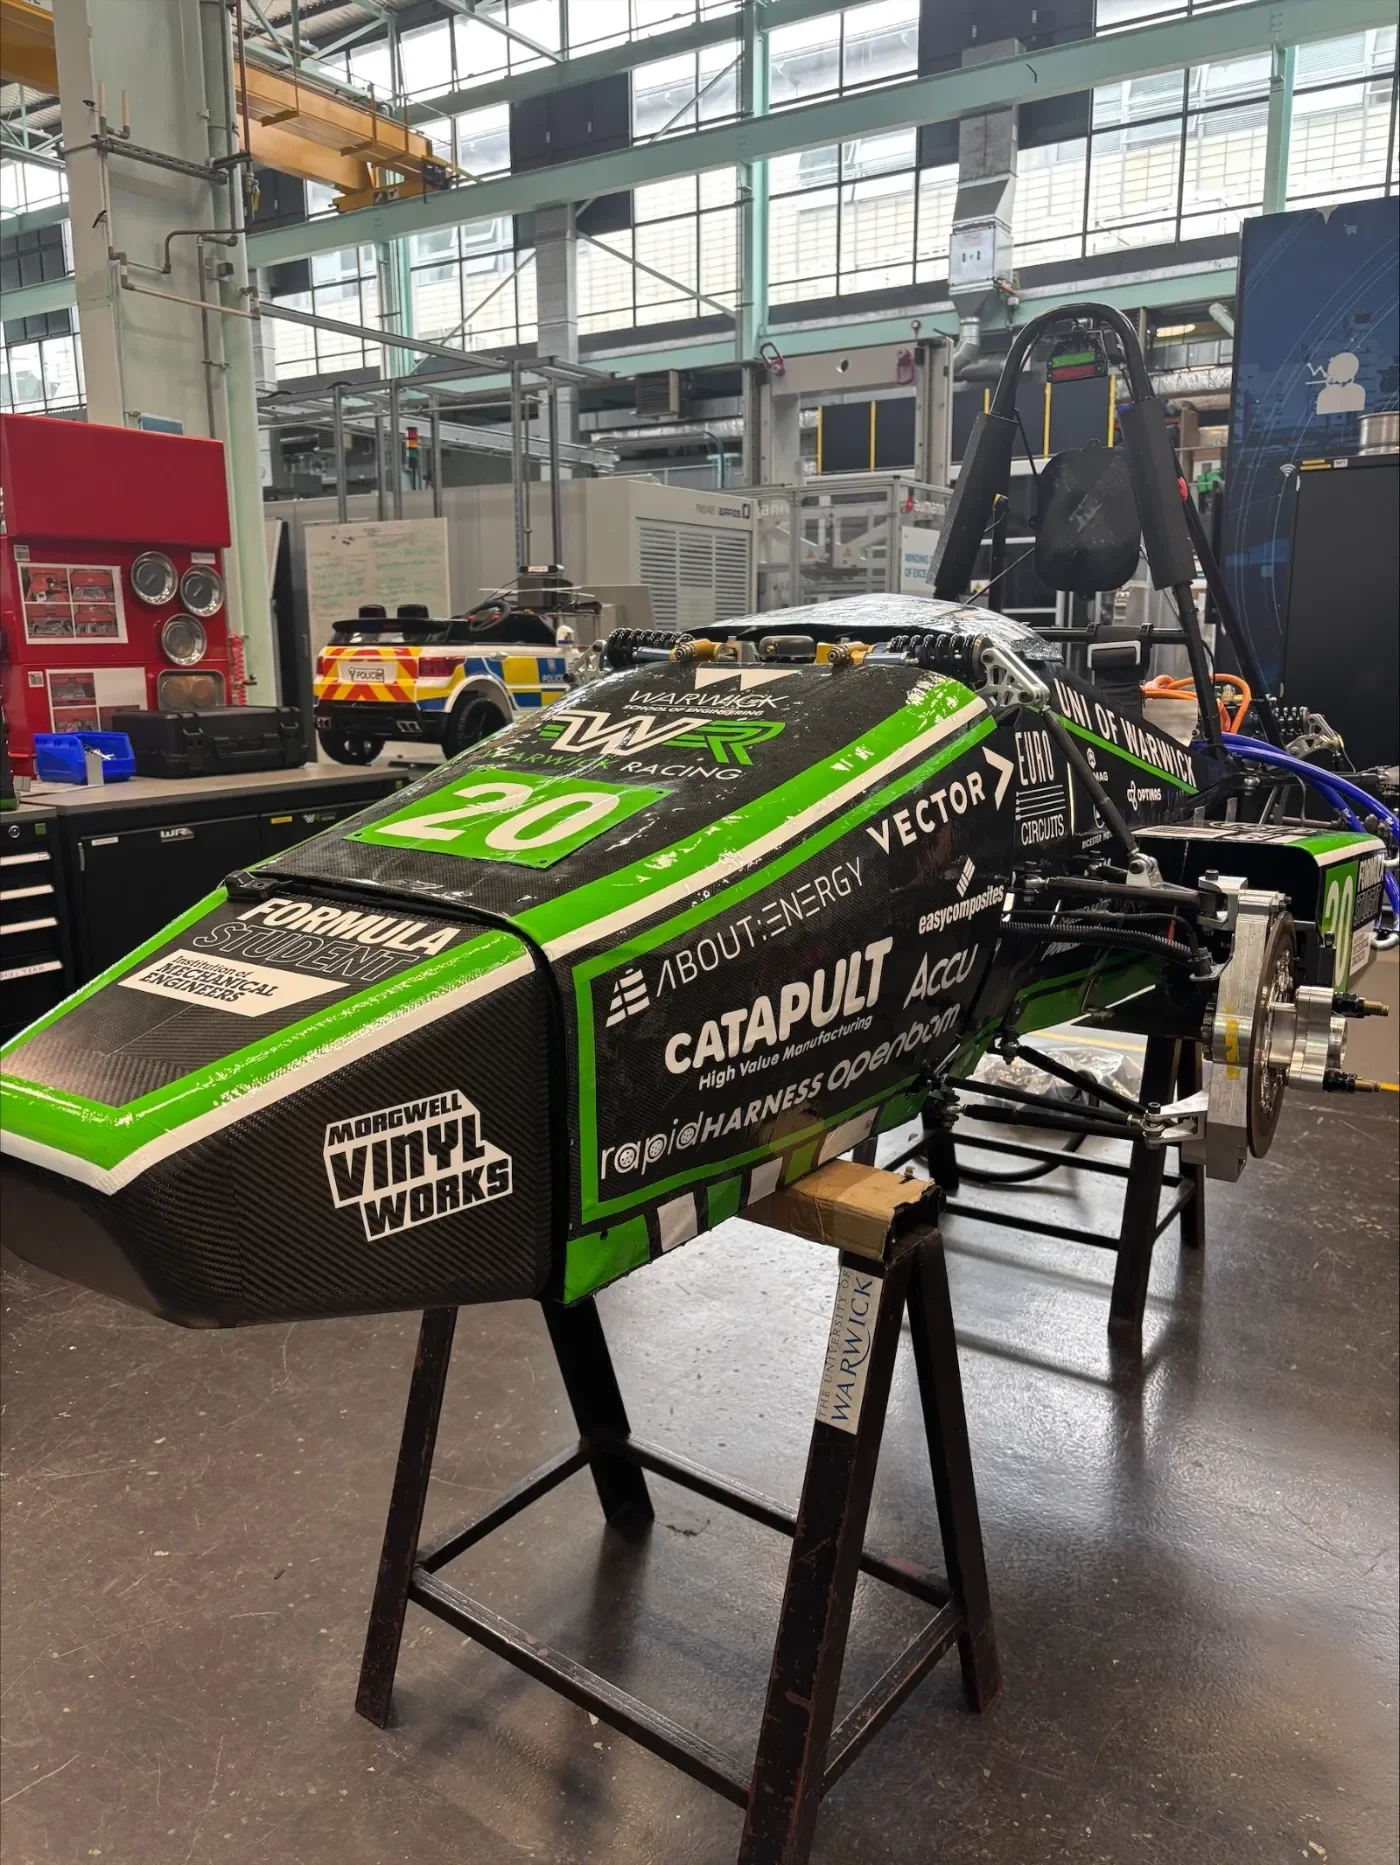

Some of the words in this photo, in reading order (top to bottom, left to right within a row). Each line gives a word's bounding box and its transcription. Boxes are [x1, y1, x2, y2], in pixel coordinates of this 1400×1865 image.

[356, 671, 381, 680] POLICE
[629, 690, 789, 709] WARWICK
[622, 704, 667, 713] SCHOOL
[685, 708, 765, 717] ENGINEERING
[1054, 678, 1092, 731] UNI
[1095, 702, 1118, 744] OF
[1120, 717, 1197, 788] WARWICK
[483, 748, 617, 770] WARWICK
[620, 762, 743, 780] RACING
[1015, 730, 1055, 786] EURO
[374, 782, 621, 851] 20
[866, 771, 986, 855] VECTOR
[1021, 814, 1065, 846] CIRCUITS
[236, 897, 461, 956] FORMULA
[918, 885, 1004, 935] easycomposites
[171, 955, 235, 976] Institution
[236, 970, 255, 979] of
[193, 921, 420, 982] STUDENT
[139, 972, 243, 1003] ENGINEERS
[155, 962, 280, 998] MECHANICAL
[664, 936, 893, 1075] CATAPULT
[699, 1064, 736, 1091] High
[739, 1053, 779, 1077] Value
[782, 1014, 873, 1062] Manufacturing
[327, 1092, 463, 1147] MORGWELL
[329, 1113, 486, 1202] VINYL
[363, 1157, 510, 1238] WORKS
[841, 1270, 852, 1289] OF
[823, 1296, 848, 1384] UNIVERSITY
[831, 1276, 874, 1421] WARWICK
[818, 1390, 830, 1418] THE
